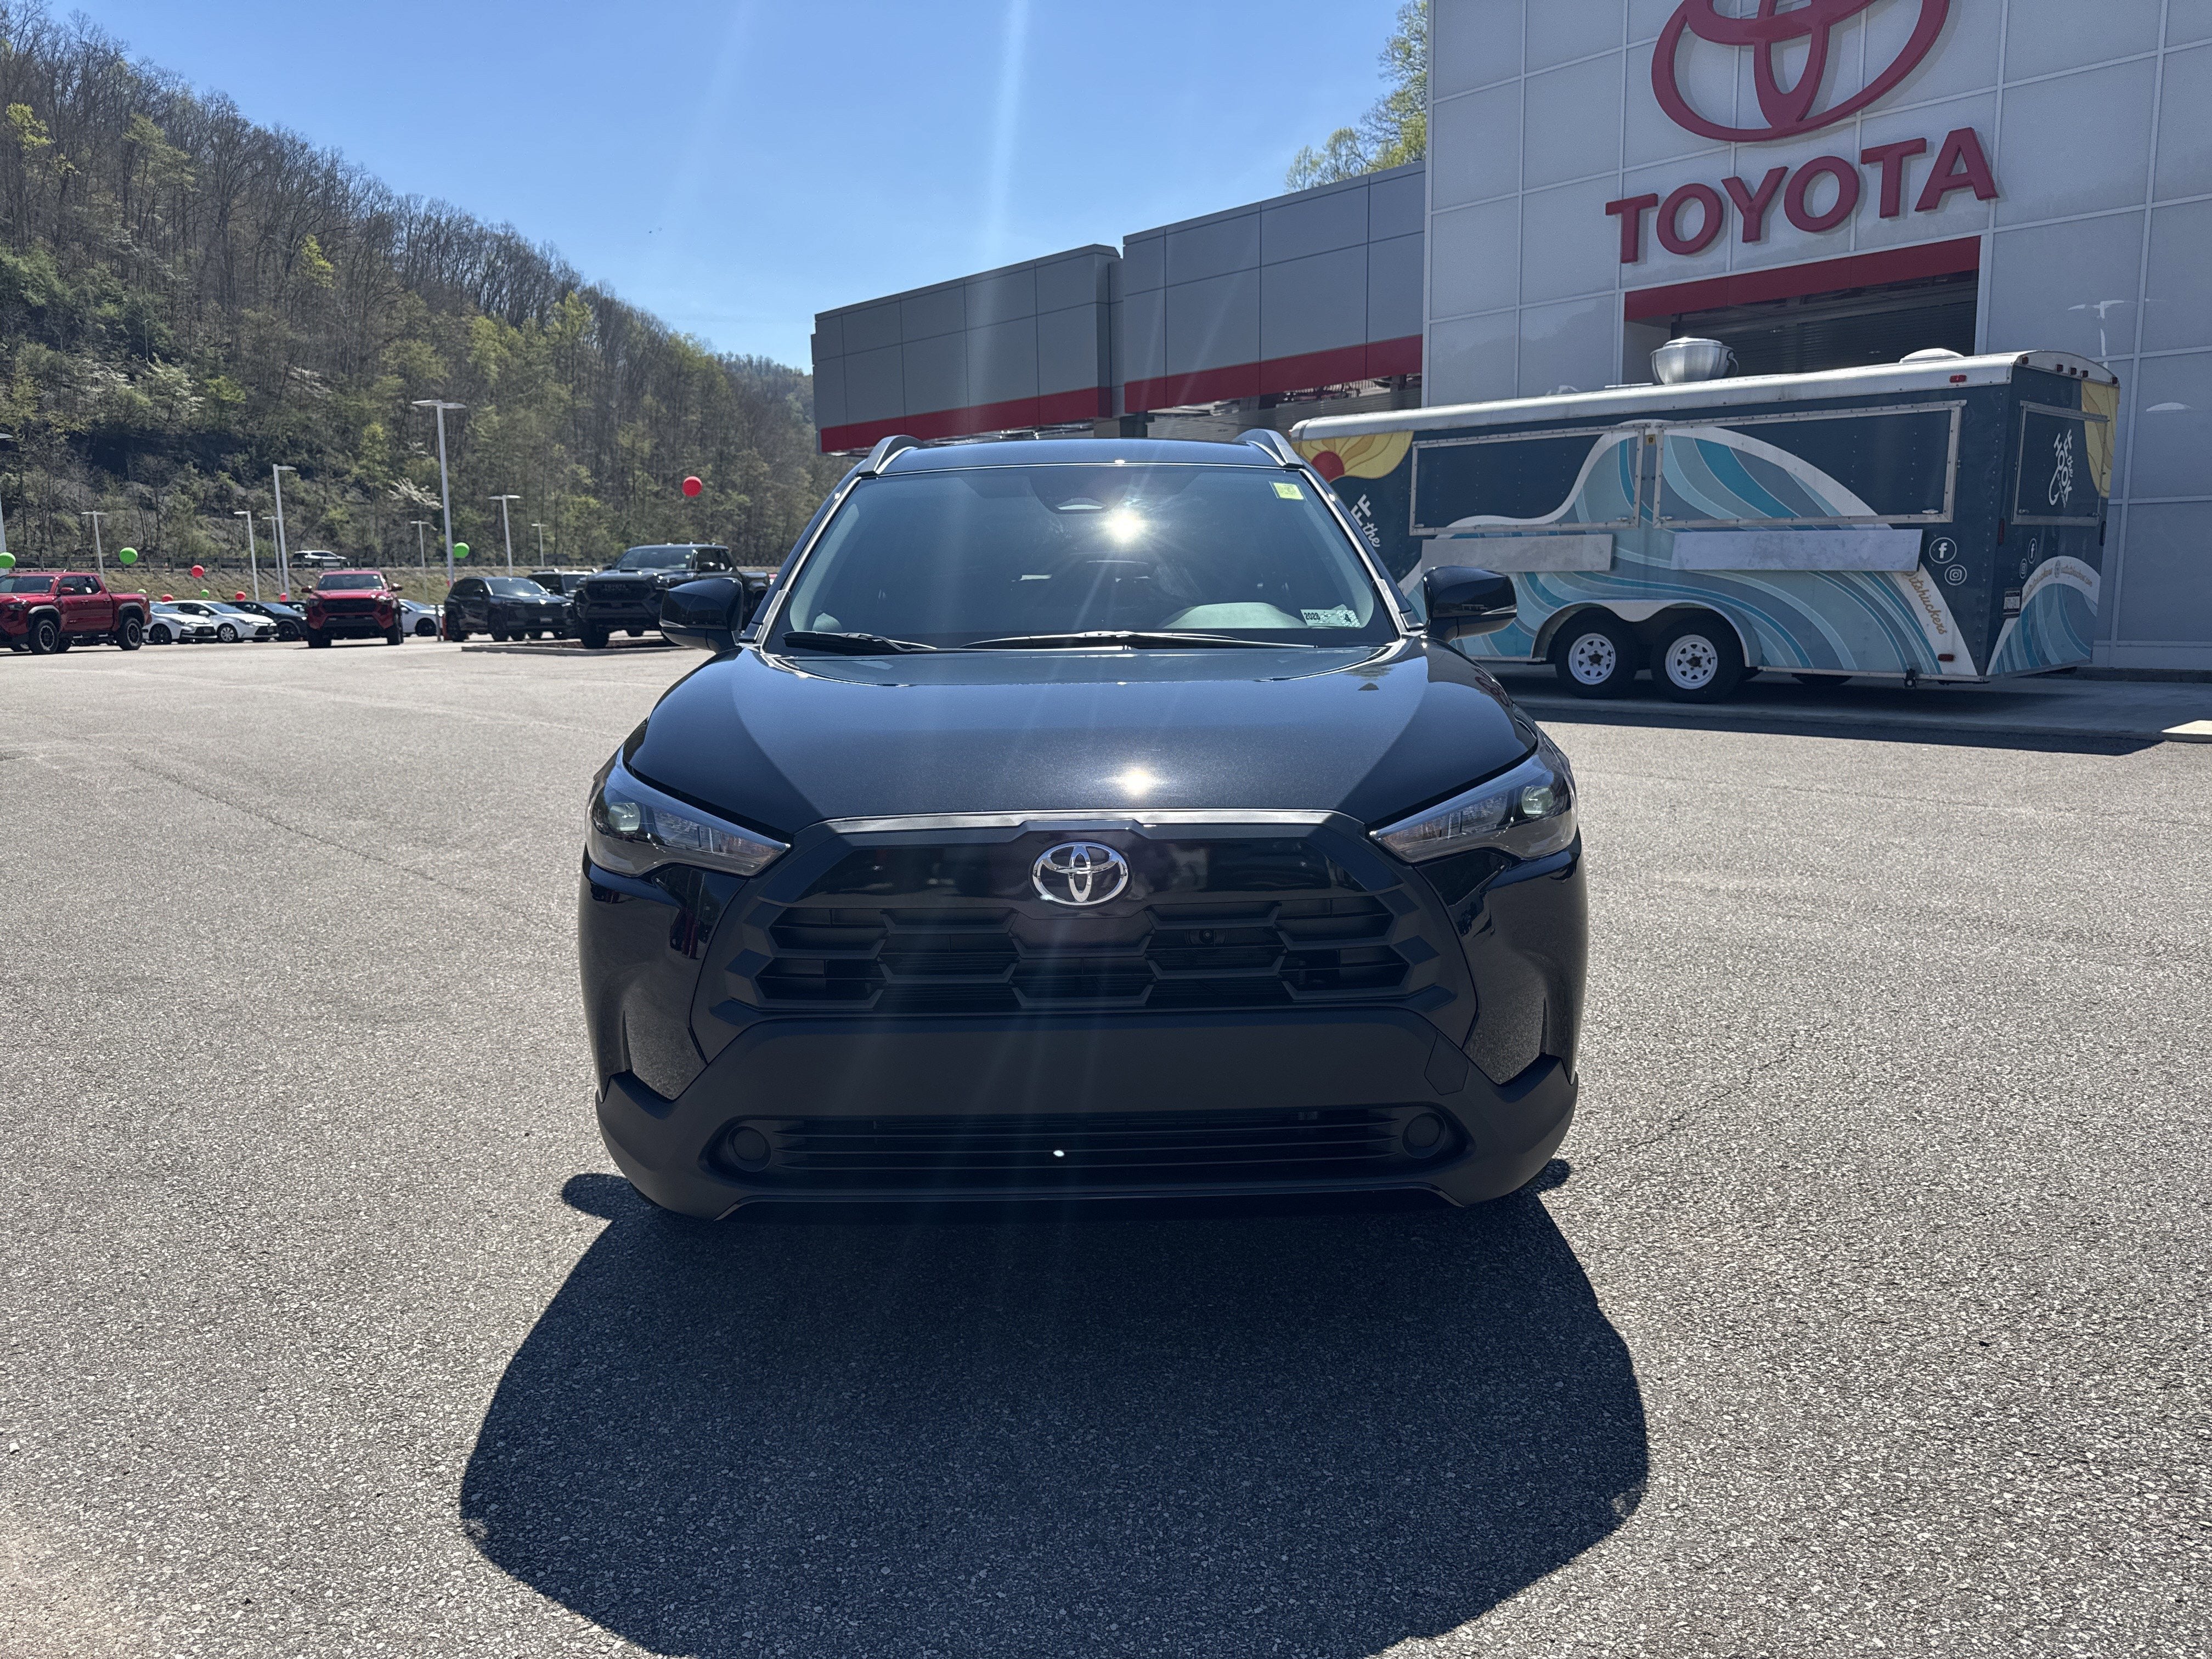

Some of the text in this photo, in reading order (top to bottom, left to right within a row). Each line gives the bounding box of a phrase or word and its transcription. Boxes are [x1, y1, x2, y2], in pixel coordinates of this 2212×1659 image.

[1605, 127, 2000, 263] TOYOTA
[1350, 494, 1380, 548] FF the
